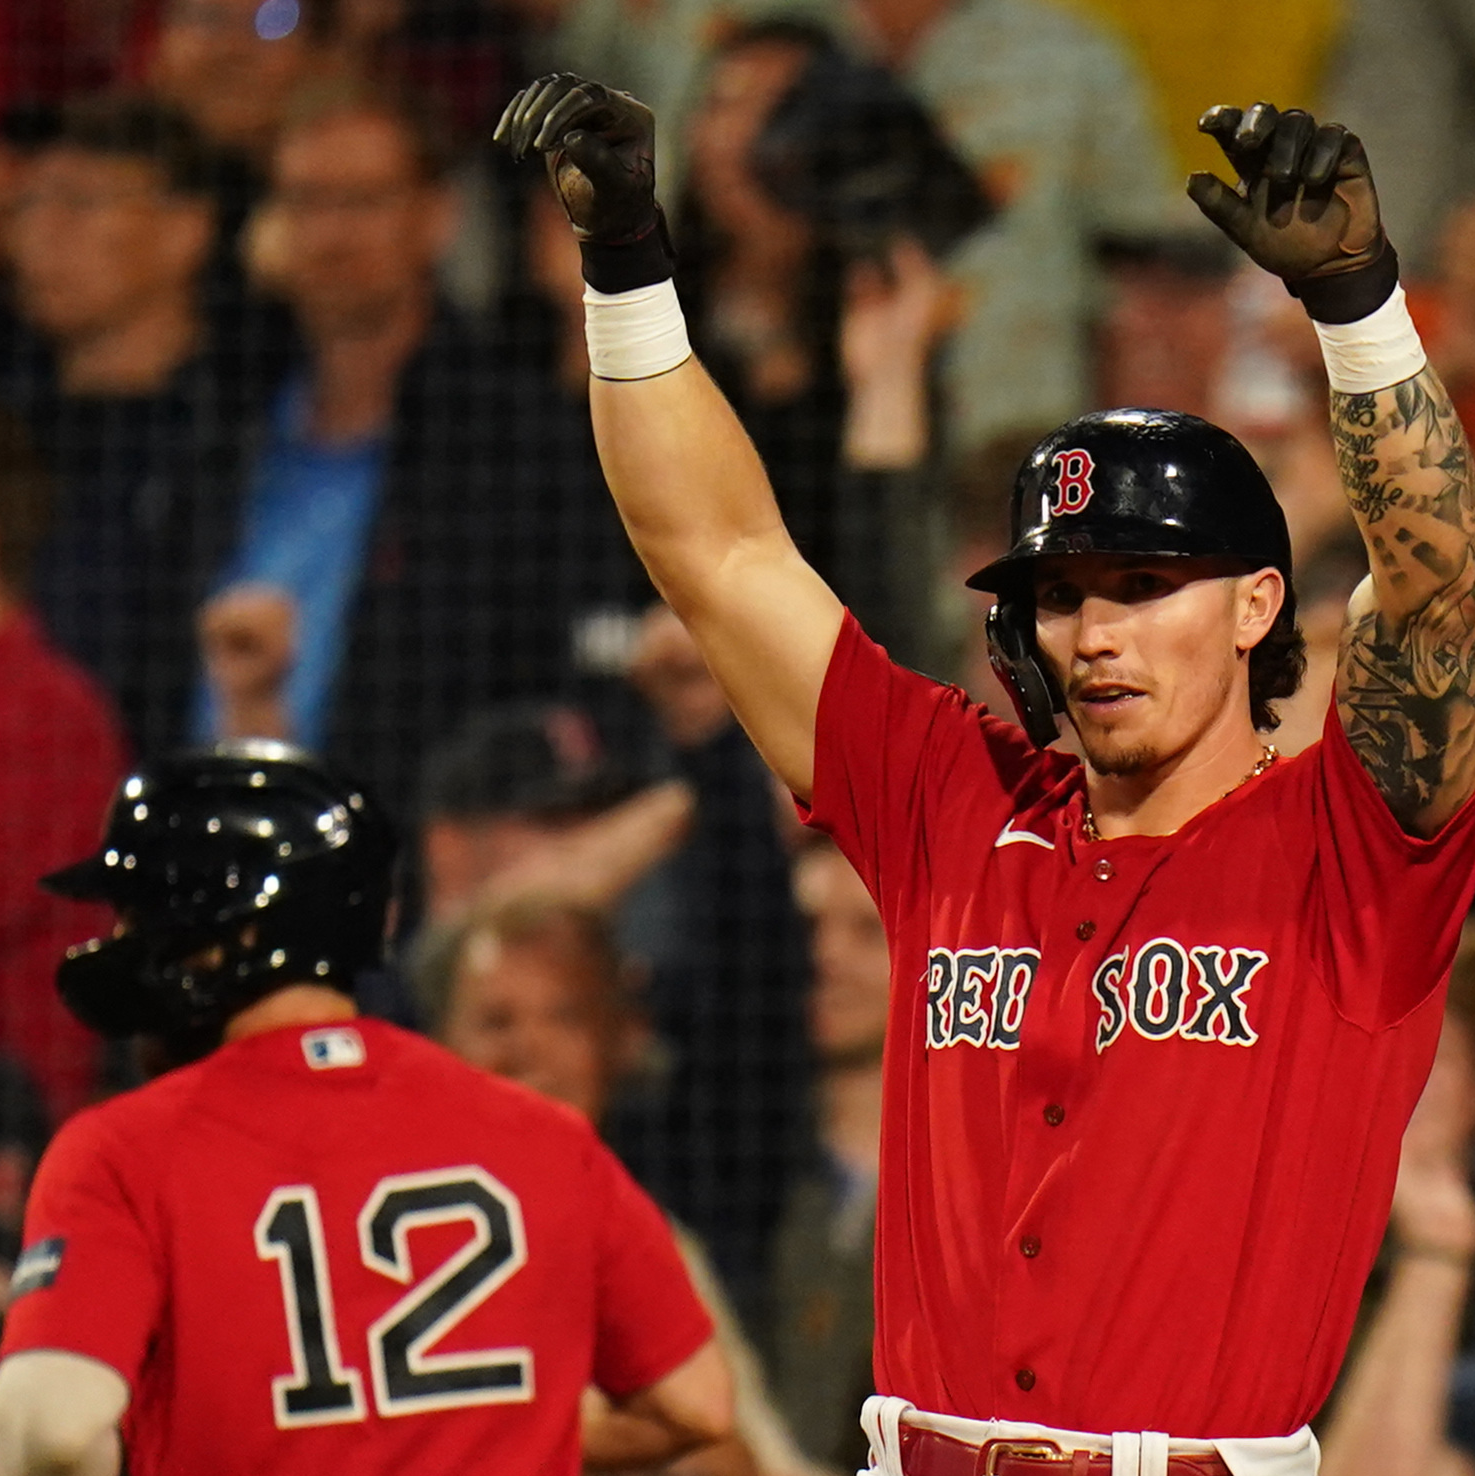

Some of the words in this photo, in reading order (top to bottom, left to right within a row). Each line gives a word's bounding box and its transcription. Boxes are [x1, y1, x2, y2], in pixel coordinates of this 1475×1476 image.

[1050, 448, 1096, 517] B
[925, 945, 1042, 1050] RED
[1091, 936, 1270, 1056] SOX
[253, 1163, 536, 1431] 12
